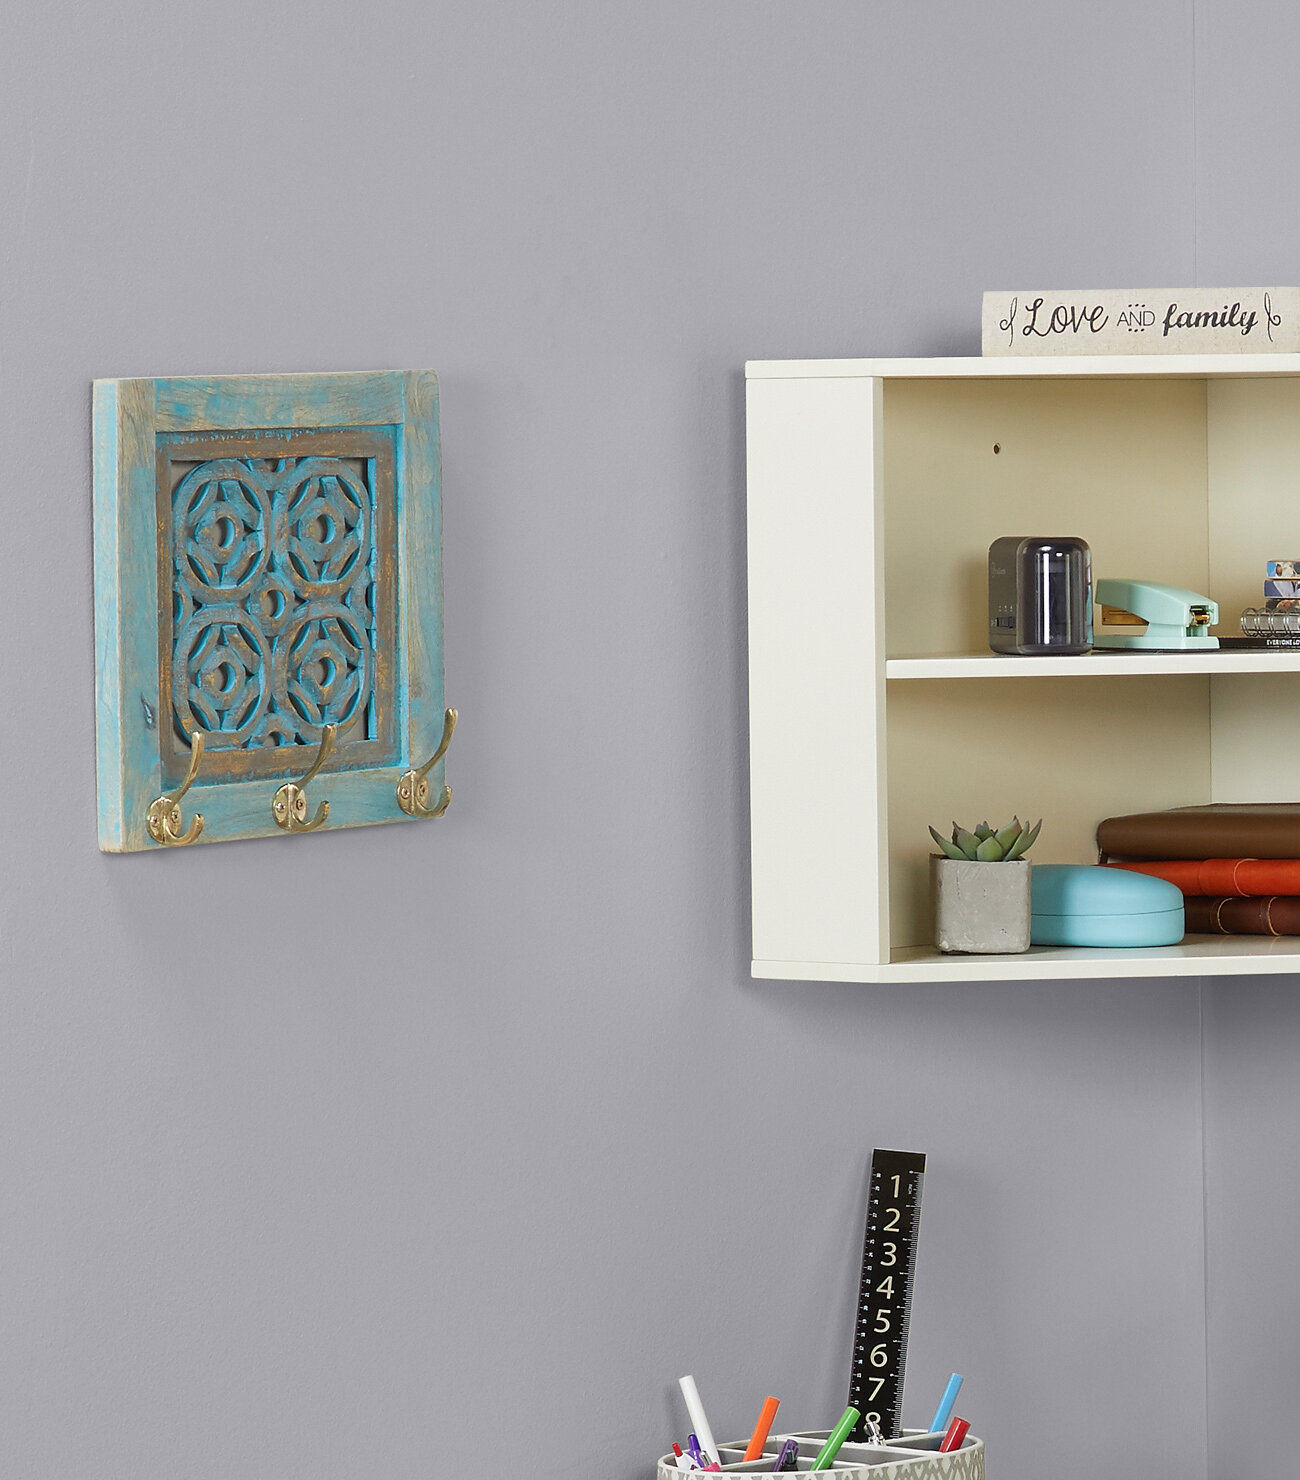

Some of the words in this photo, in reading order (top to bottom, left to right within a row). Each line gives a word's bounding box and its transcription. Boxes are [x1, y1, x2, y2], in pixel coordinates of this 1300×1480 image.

[1022, 297, 1109, 338] Love
[1116, 310, 1156, 328] AND
[1162, 302, 1259, 337] family
[890, 1174, 901, 1198] 1
[883, 1207, 901, 1233] 2
[880, 1242, 897, 1267] 3
[875, 1275, 895, 1300] 4
[873, 1308, 892, 1333] 5
[870, 1343, 888, 1368] 6
[868, 1377, 885, 1401] 7
